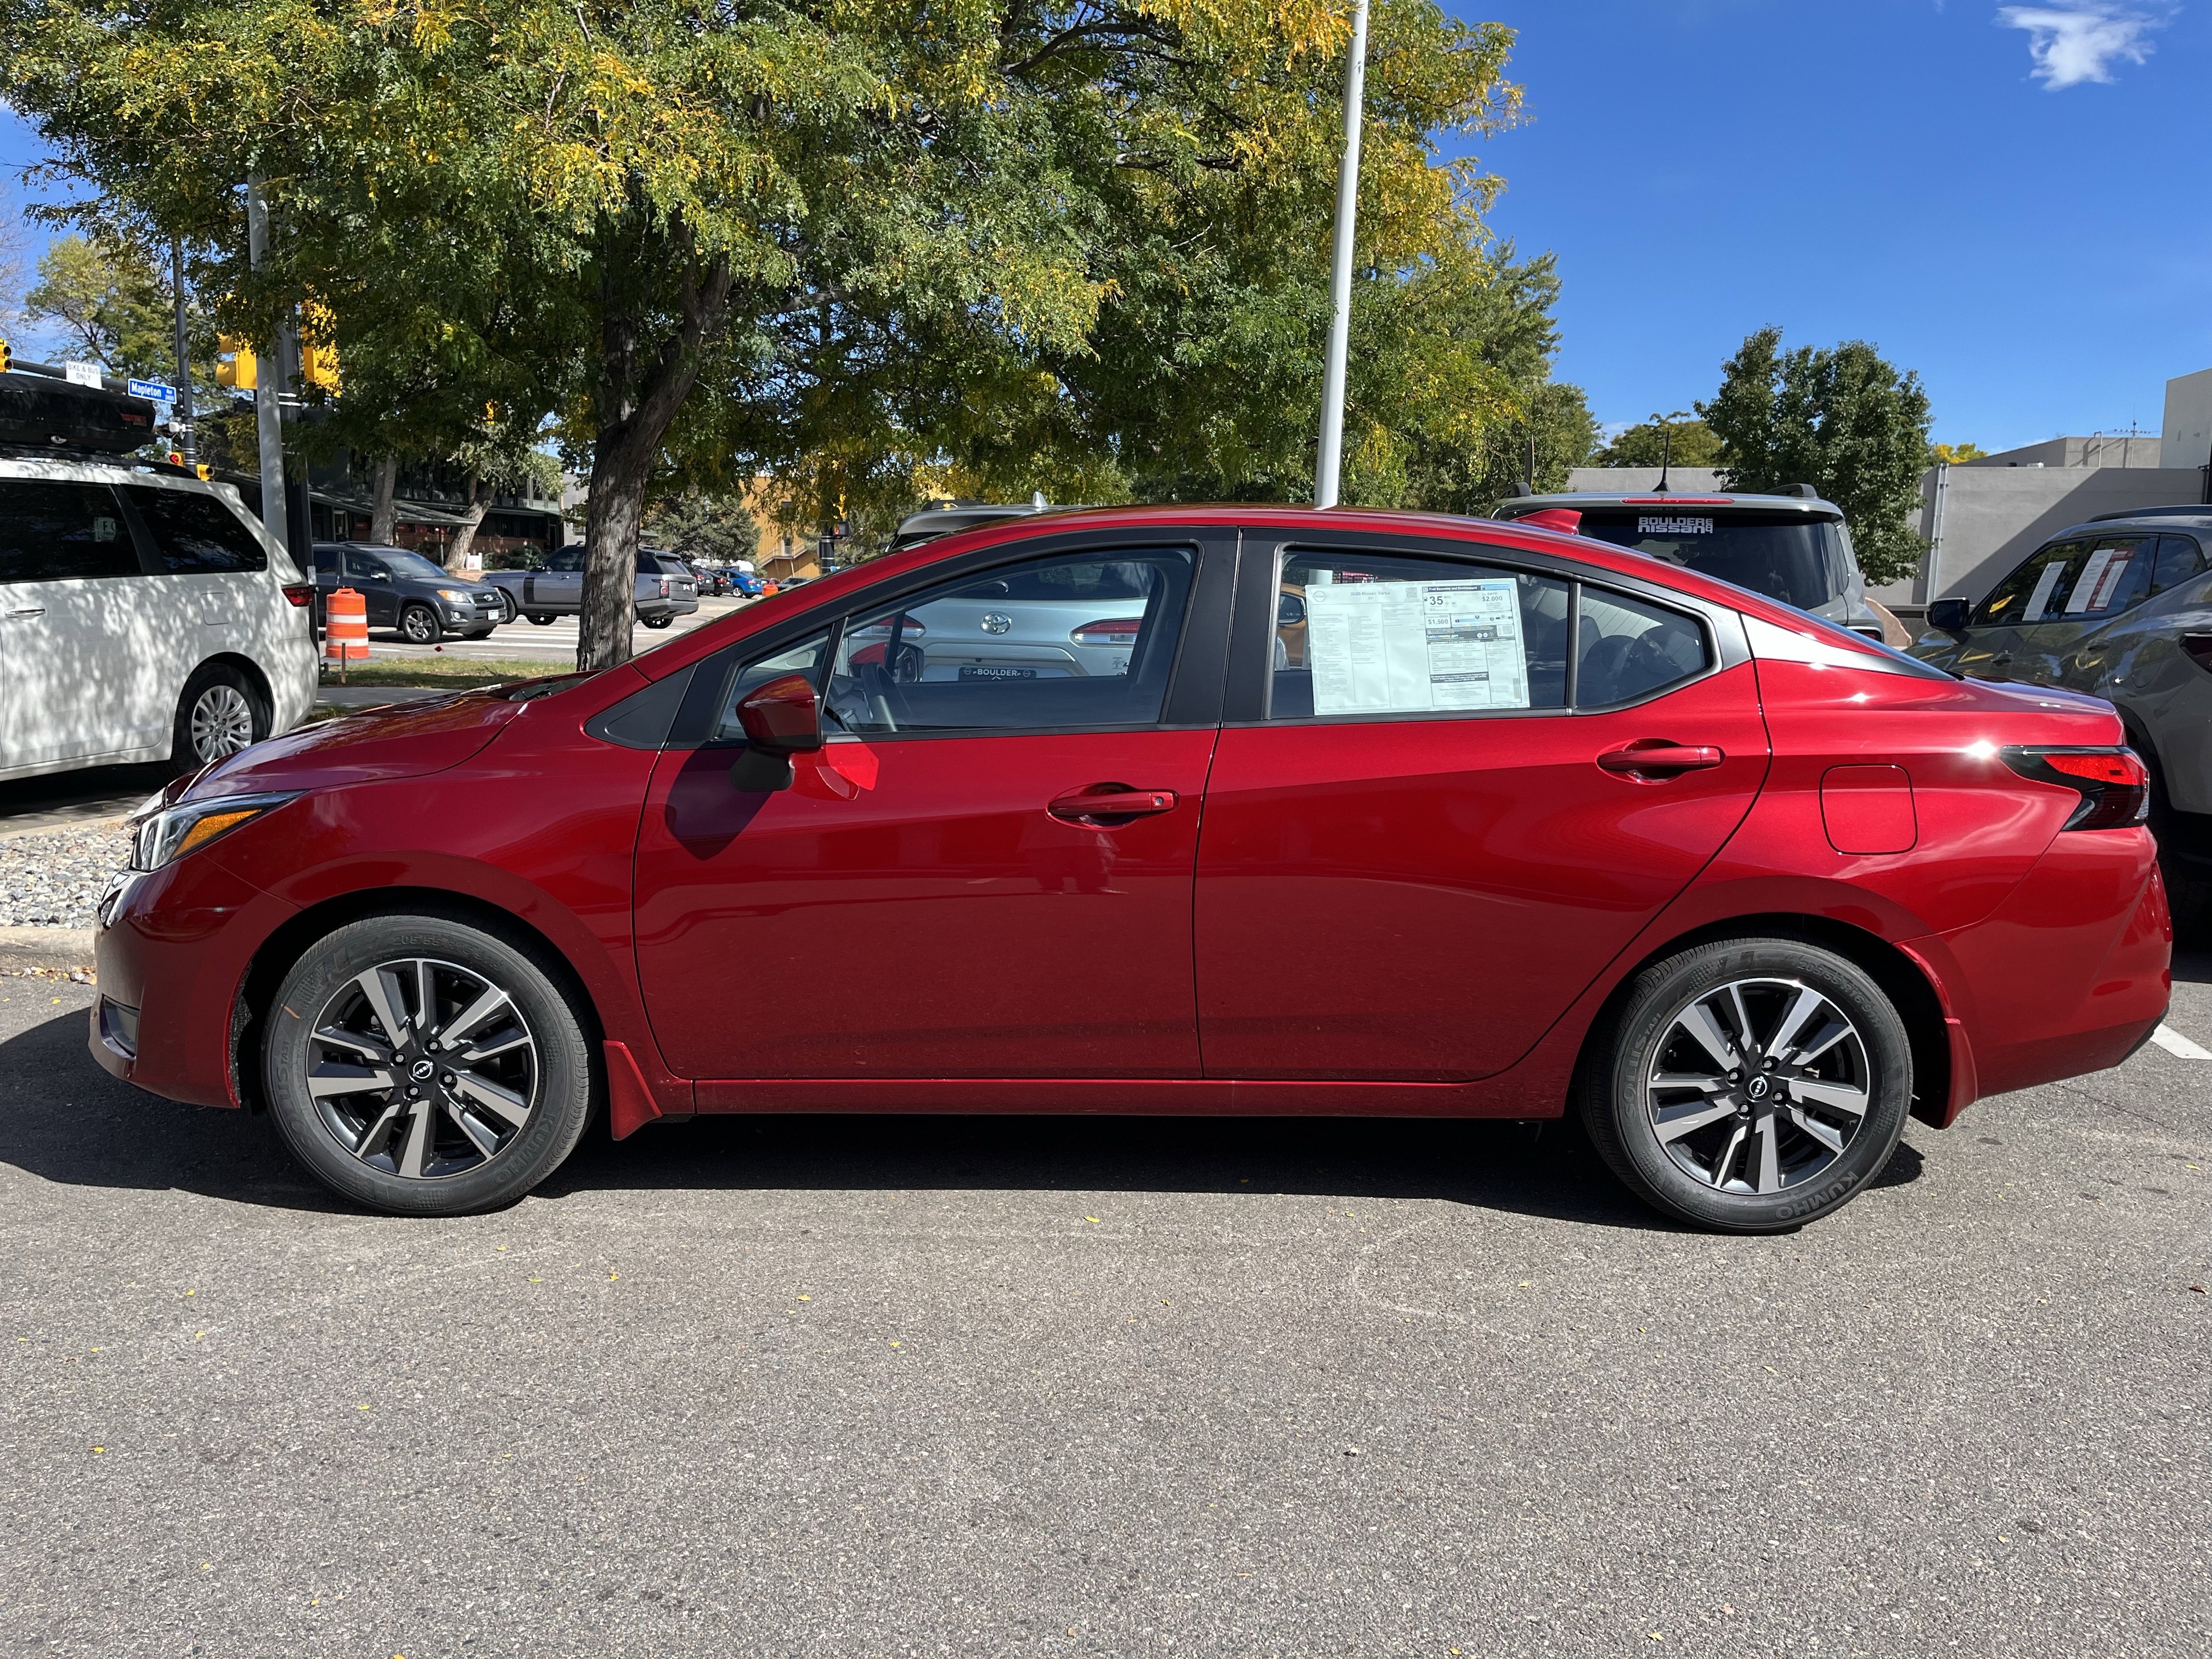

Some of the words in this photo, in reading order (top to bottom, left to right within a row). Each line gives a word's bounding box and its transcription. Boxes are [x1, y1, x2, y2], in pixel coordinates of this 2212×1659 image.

[68, 363, 80, 371] BIKE
[131, 382, 161, 398] Mapleton
[1639, 517, 1705, 526] BOULDER
[1429, 596, 1443, 605] 35
[977, 668, 1017, 676] BOULDER
[1623, 1034, 1647, 1120] SOLUS
[494, 1113, 556, 1184] KUMHO
[1775, 1171, 1859, 1220] KUMHO
